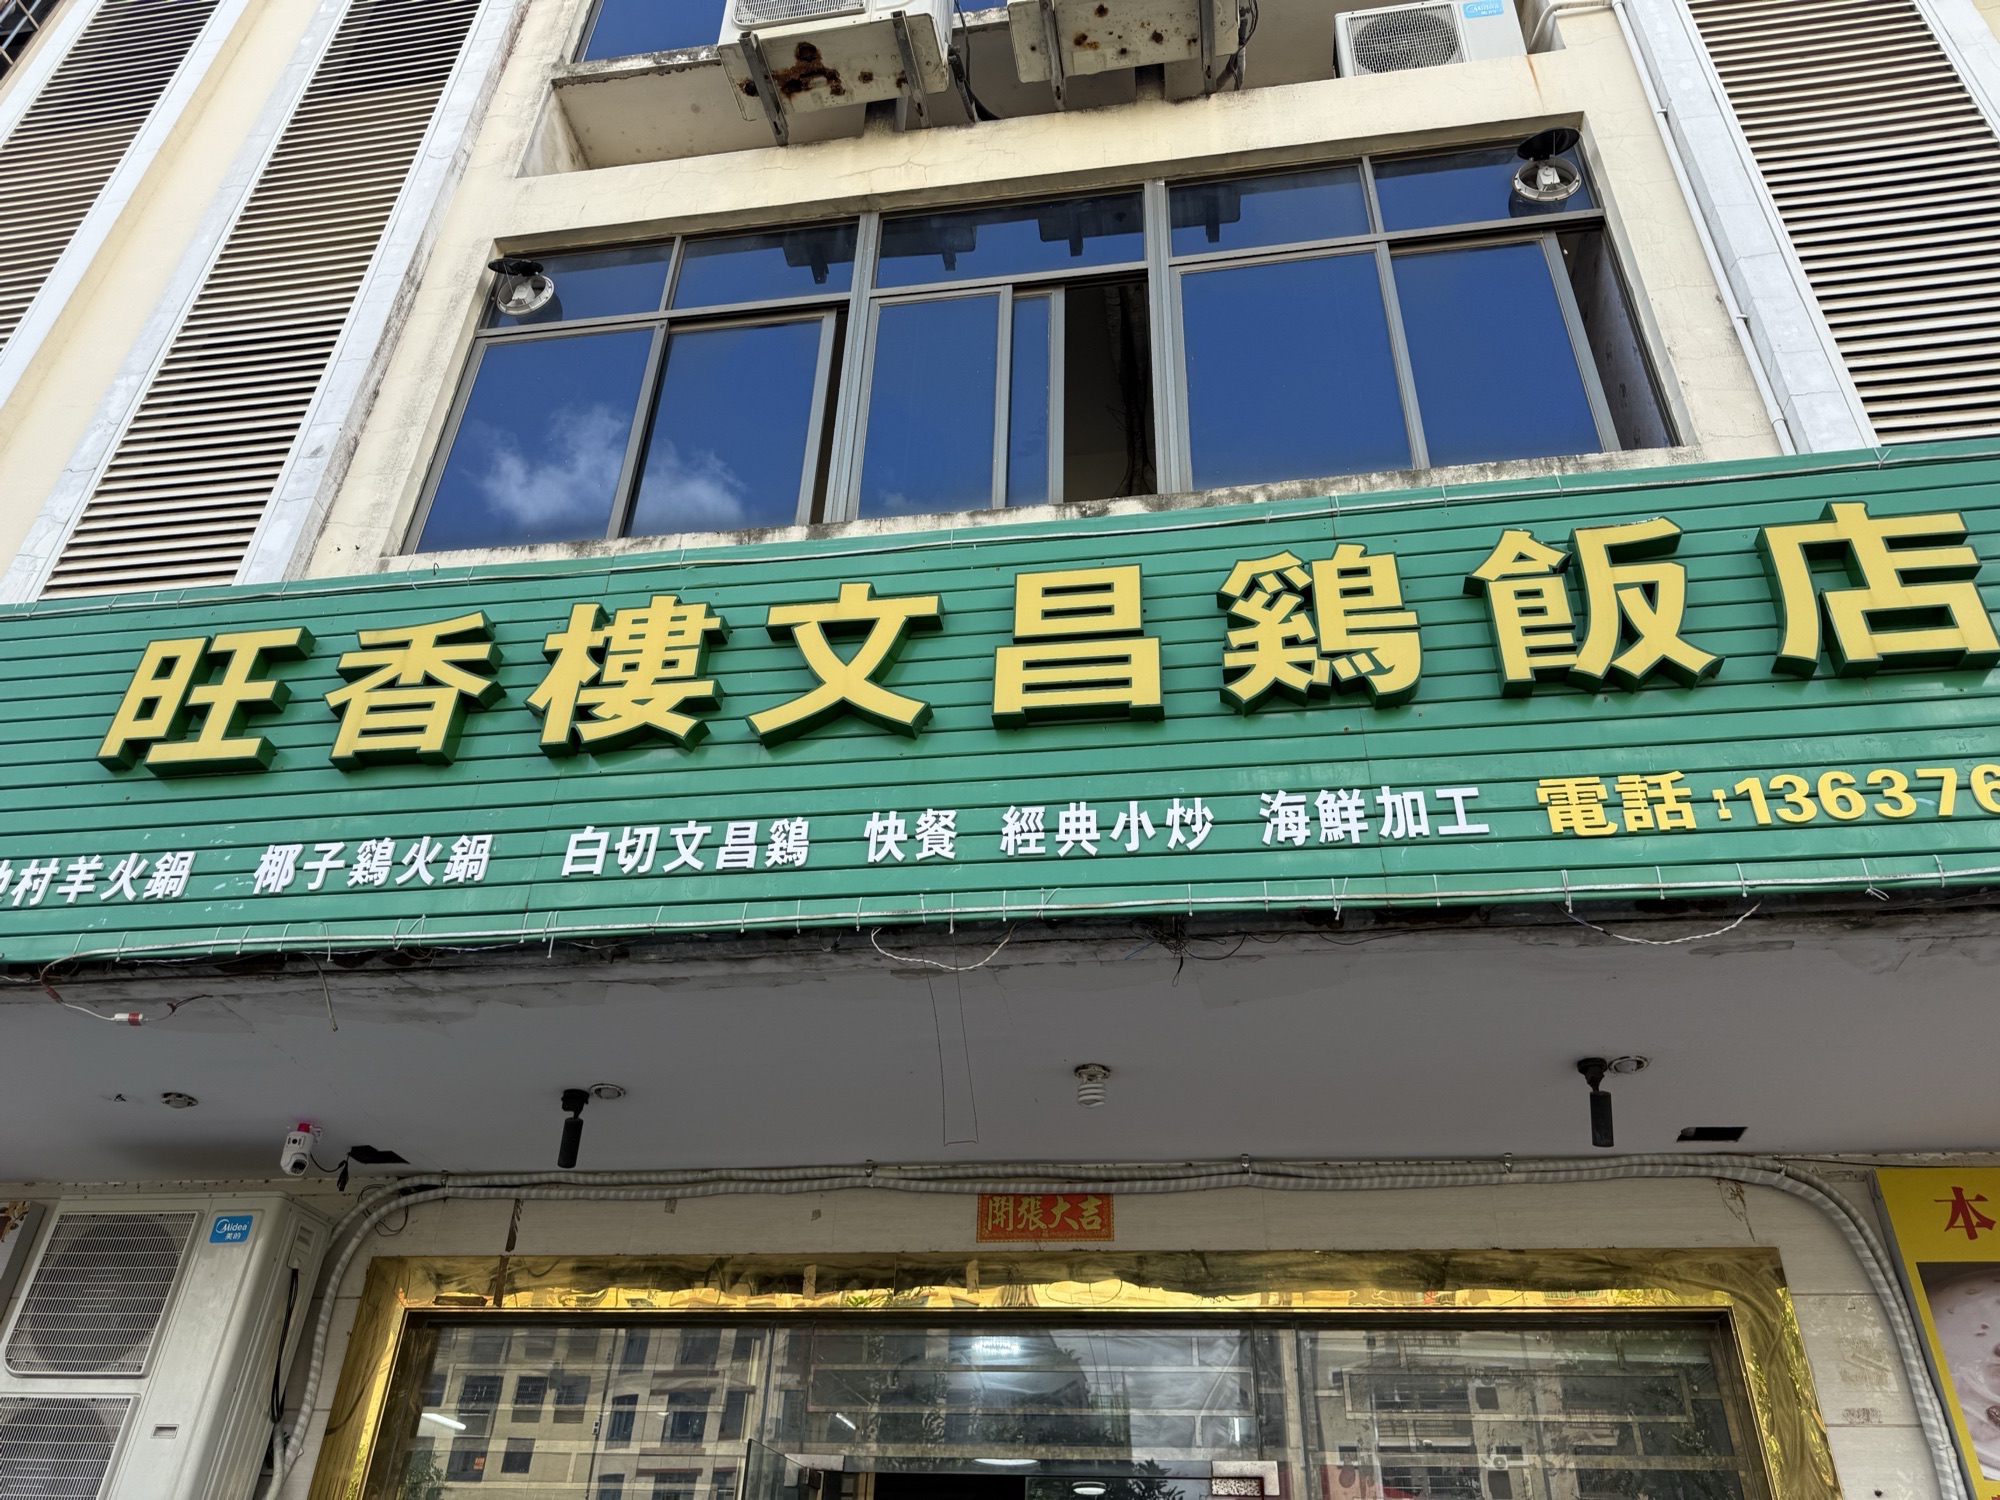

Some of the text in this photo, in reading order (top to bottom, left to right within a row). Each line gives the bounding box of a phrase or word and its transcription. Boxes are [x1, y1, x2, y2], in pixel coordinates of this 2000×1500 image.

[863, 809, 958, 863] 快餐
[999, 797, 1214, 858] 經典小炒
[1259, 785, 1490, 846] 海鮮加工
[216, 1219, 248, 1234] Midea
[1933, 1186, 1997, 1241] 本
